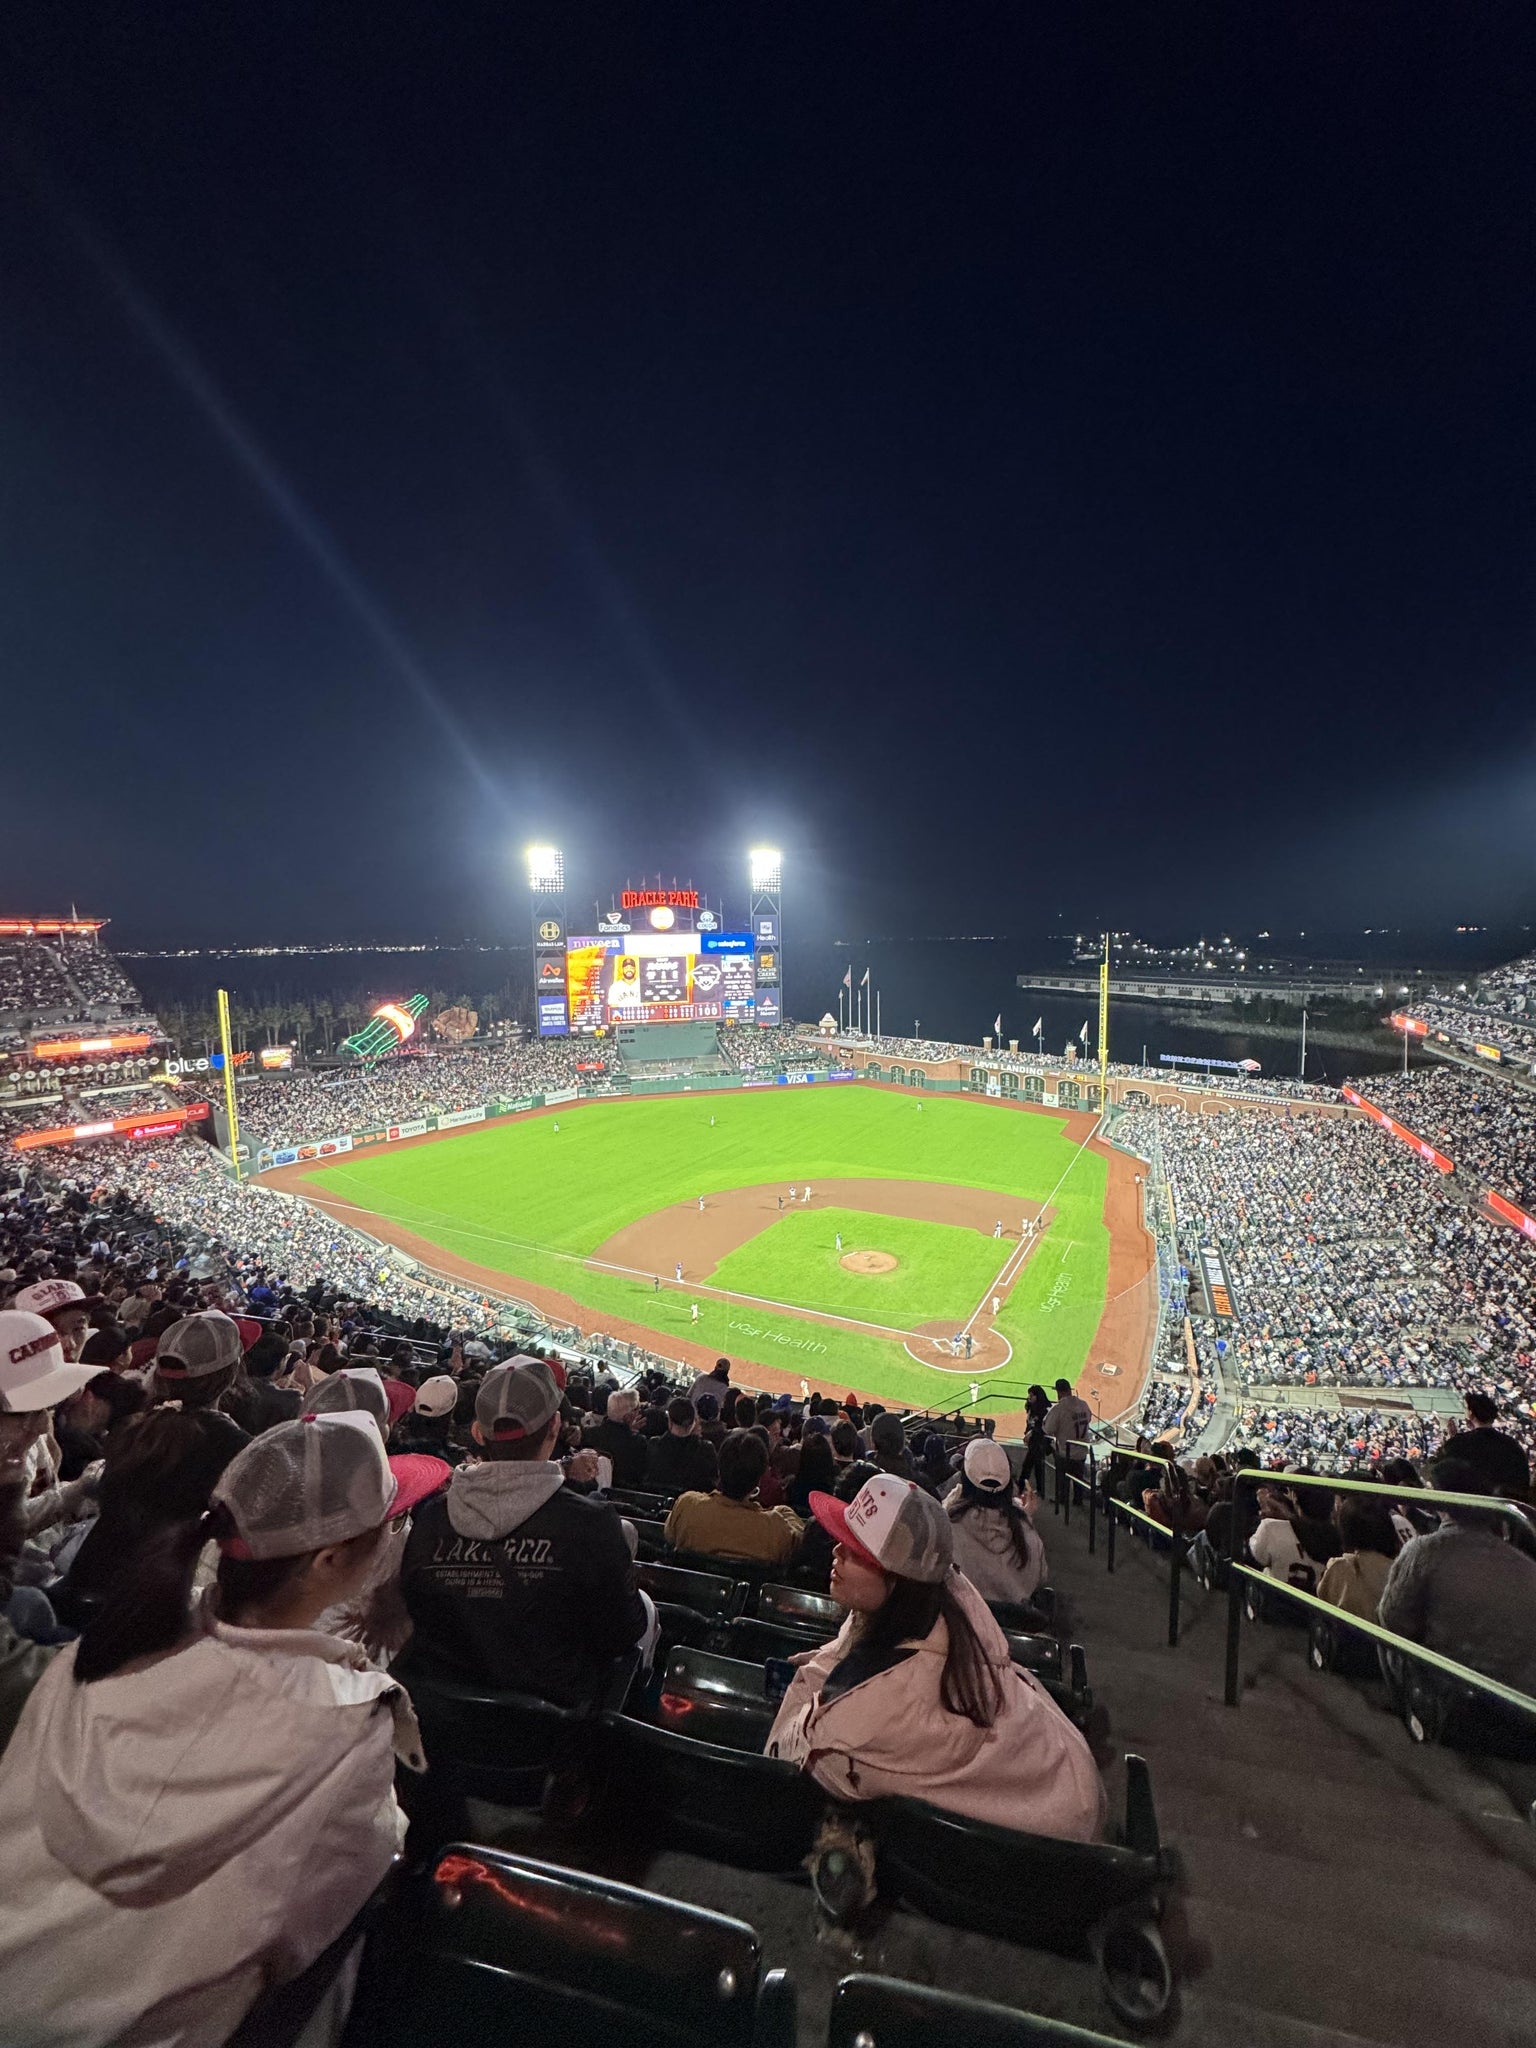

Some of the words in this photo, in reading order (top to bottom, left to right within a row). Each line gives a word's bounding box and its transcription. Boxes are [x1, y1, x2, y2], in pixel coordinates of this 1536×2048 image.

[622, 890, 667, 909] ORACLE
[668, 890, 699, 909] PARK
[599, 923, 631, 932] Fanatics
[573, 939, 620, 949] nuveen
[165, 1057, 210, 1075] blue
[1001, 1061, 1044, 1077] LANDING
[786, 1073, 809, 1084] VISA
[507, 1098, 533, 1111] National
[473, 1110, 483, 1119] Life
[144, 1123, 178, 1134] Budweiser
[402, 1124, 425, 1135] TOYOTA
[1048, 1272, 1073, 1297] Health
[729, 1320, 763, 1337] UCSF
[762, 1330, 828, 1354] Health
